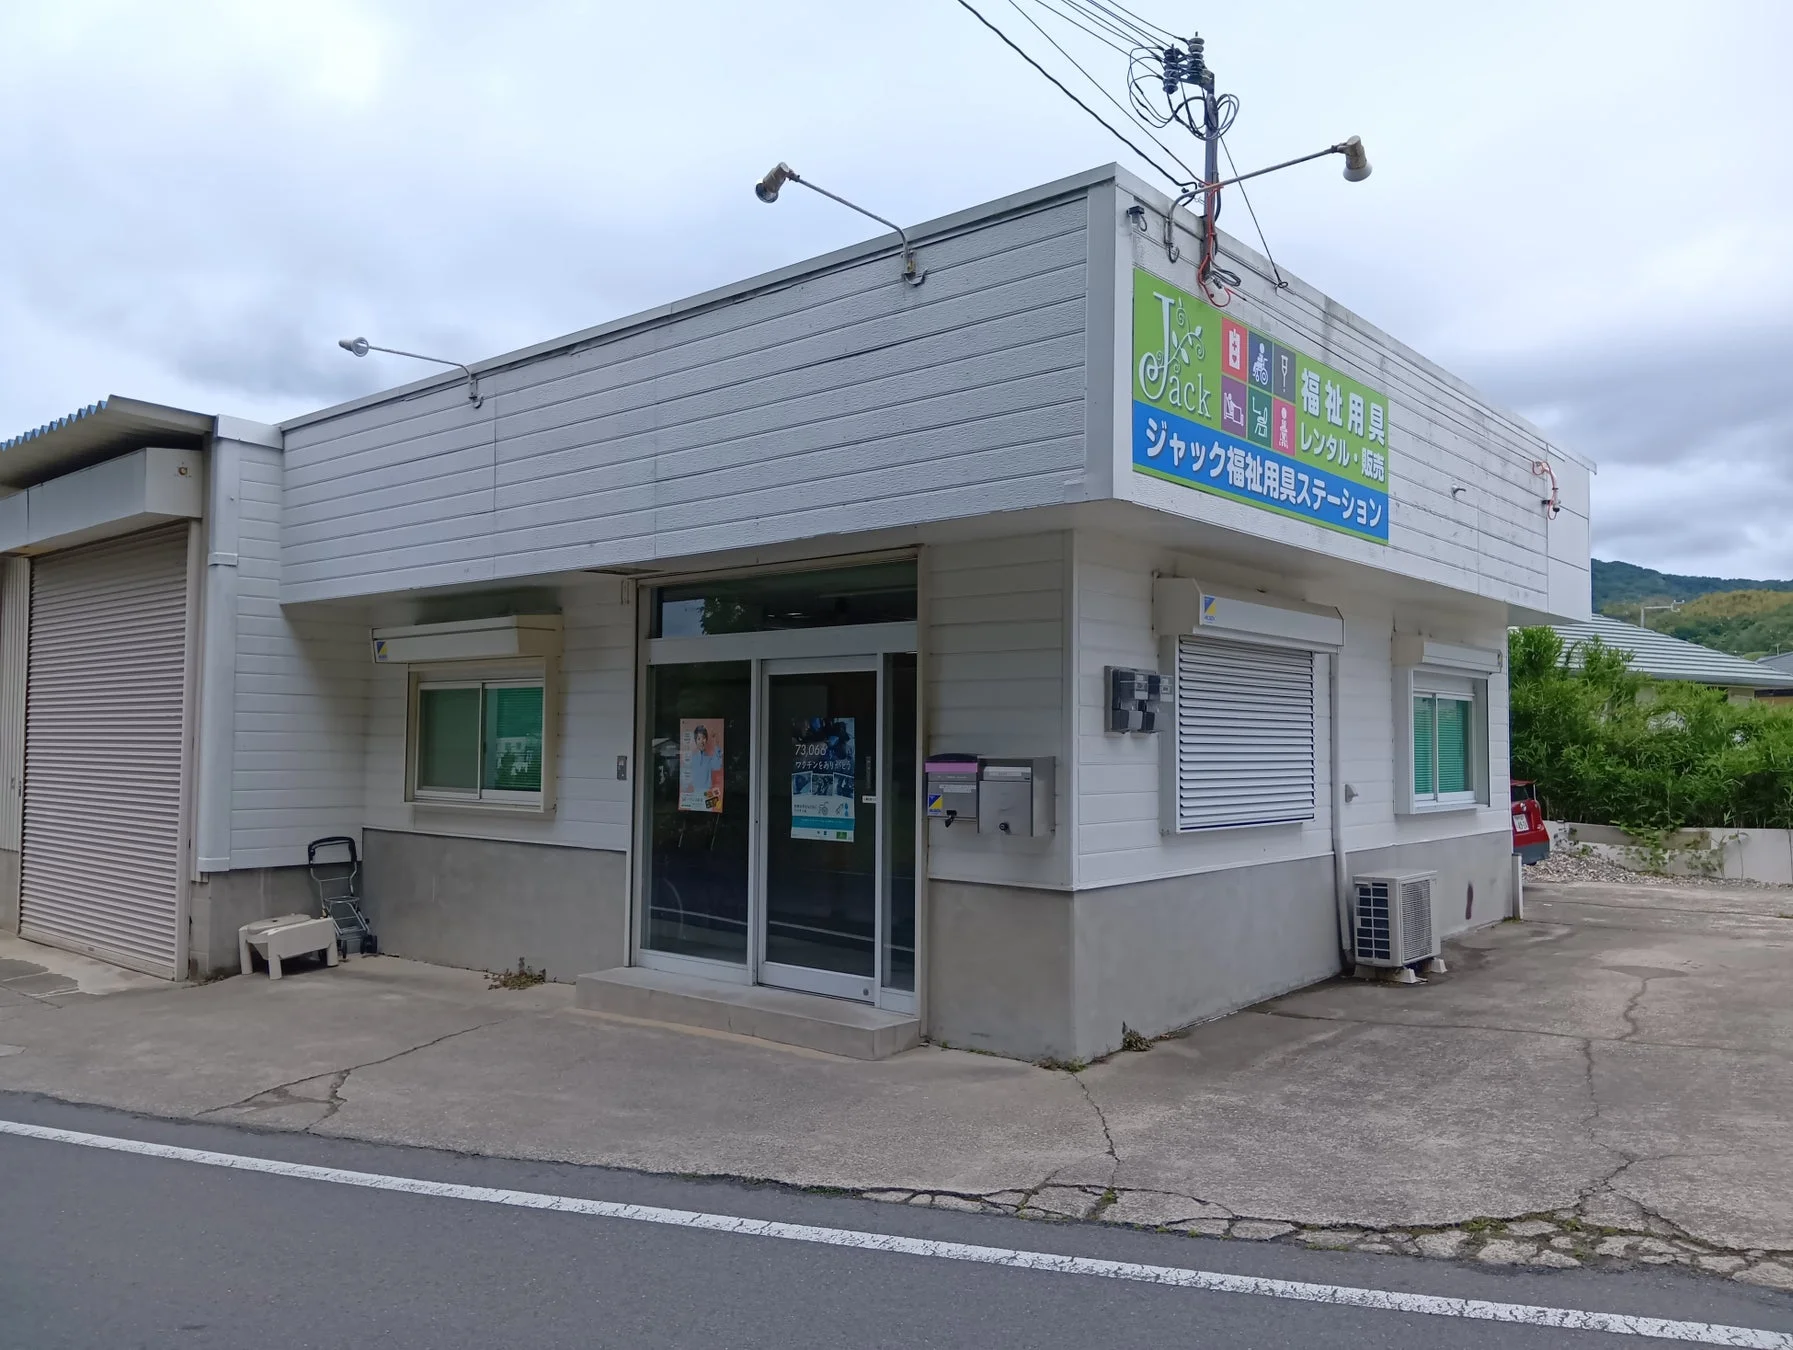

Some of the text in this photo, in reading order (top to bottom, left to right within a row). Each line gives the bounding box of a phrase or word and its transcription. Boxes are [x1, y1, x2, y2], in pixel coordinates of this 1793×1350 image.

[1139, 291, 1211, 418] Jack
[1301, 368, 1385, 446] 福祉用具
[1301, 422, 1385, 482] レンタル・販売
[1146, 417, 1381, 527] ジャック福祉用具ステーション
